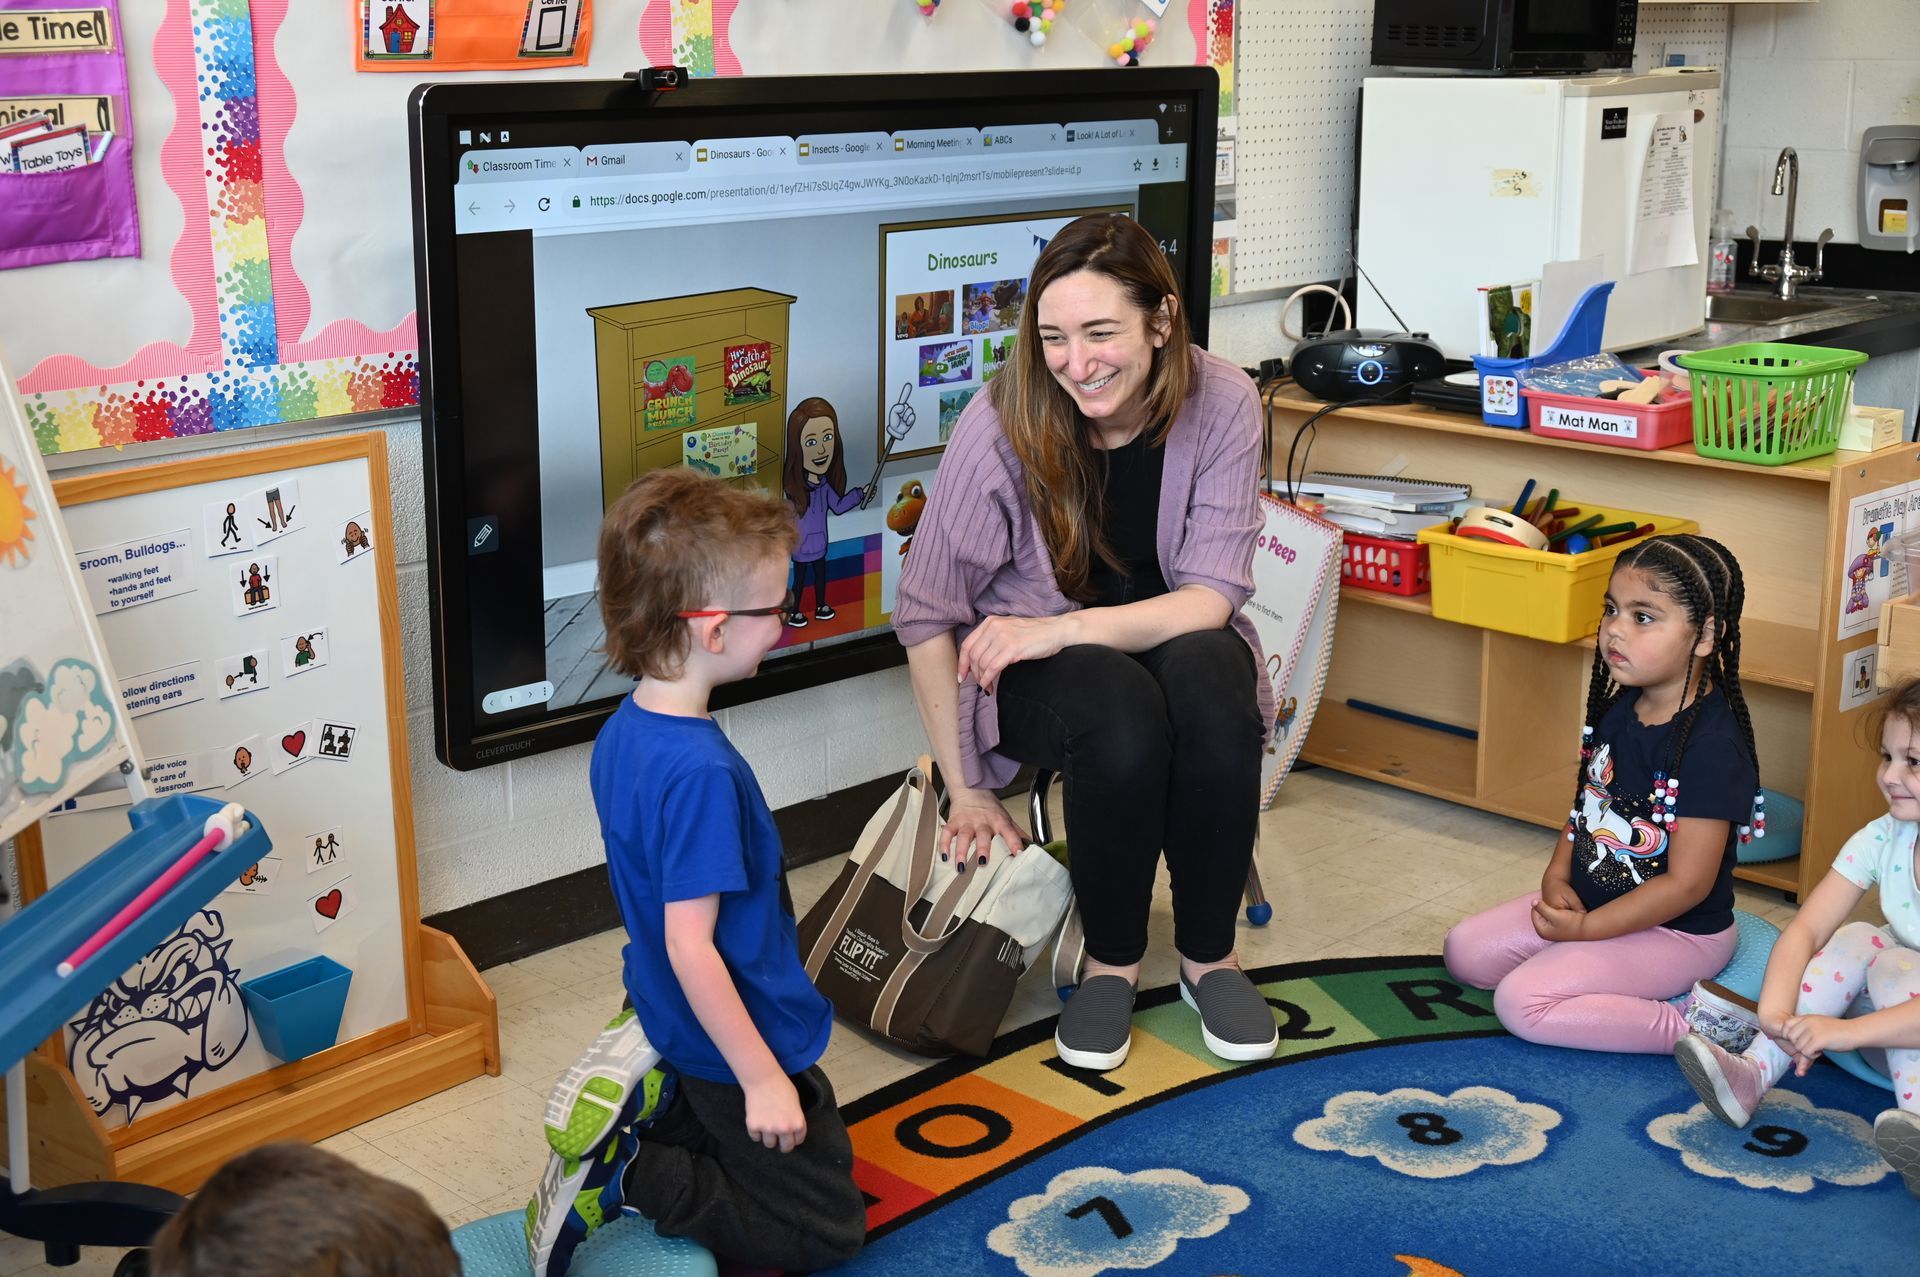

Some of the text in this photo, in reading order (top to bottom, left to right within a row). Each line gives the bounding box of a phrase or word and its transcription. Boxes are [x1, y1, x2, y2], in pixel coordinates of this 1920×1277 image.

[27, 16, 94, 41] Time
[811, 143, 839, 155] Insects
[906, 139, 935, 153] Morning
[994, 134, 1013, 145] ABCs
[21, 155, 54, 171] Table
[55, 147, 83, 162] Toys
[601, 154, 626, 166] Gmail
[710, 148, 750, 160] Dinosaurs
[482, 159, 533, 173] Classroom
[927, 251, 998, 271] Dinosaurs
[730, 348, 745, 361] How
[739, 349, 760, 368] Catch
[728, 359, 768, 388] Dinosaur
[647, 395, 693, 410] CRUNCH
[647, 406, 693, 421] MUNCH
[1558, 413, 1619, 433] Mat Man
[1893, 498, 1908, 519] Play
[1258, 535, 1297, 566] o Peep
[80, 554, 122, 572] sroom,
[143, 565, 159, 577] feet
[138, 579, 154, 592] and
[154, 574, 172, 588] feet
[110, 589, 155, 609] to yourself
[122, 673, 196, 699] ollow directions
[126, 688, 183, 711] stening ears
[150, 759, 187, 772] side voice
[160, 773, 176, 784] care
[178, 770, 187, 780] of
[154, 781, 194, 795] classroom
[839, 934, 864, 959] FLIP
[894, 1103, 1014, 1160] O
[1386, 979, 1497, 1021] R
[1395, 1111, 1464, 1147] 8
[1743, 1125, 1809, 1158] 9
[1064, 1196, 1134, 1240] 7
